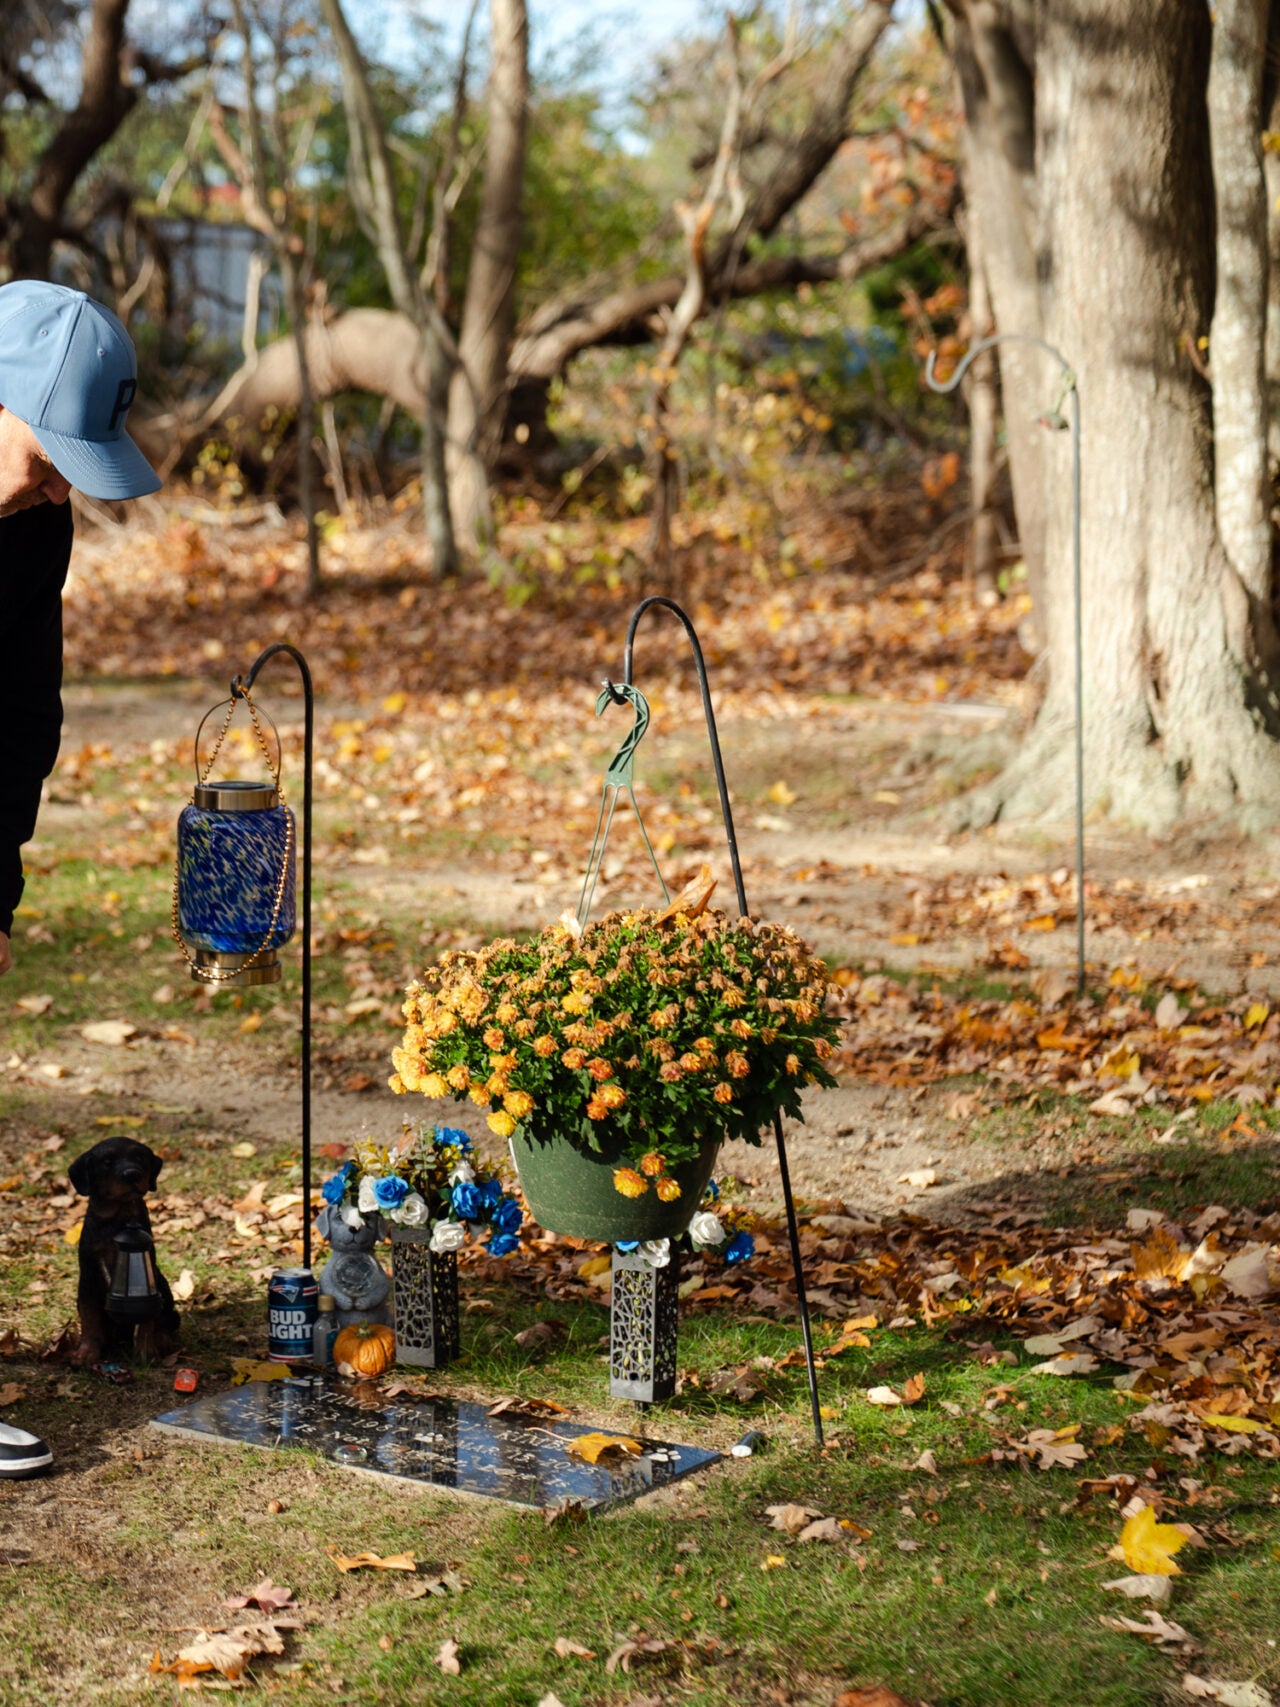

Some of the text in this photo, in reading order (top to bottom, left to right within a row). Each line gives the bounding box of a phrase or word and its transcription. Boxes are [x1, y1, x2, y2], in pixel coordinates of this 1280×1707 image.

[270, 1310, 306, 1325] BUD
[269, 1324, 313, 1339] LIGHT
[316, 1391, 432, 1420] TIMOTHY
